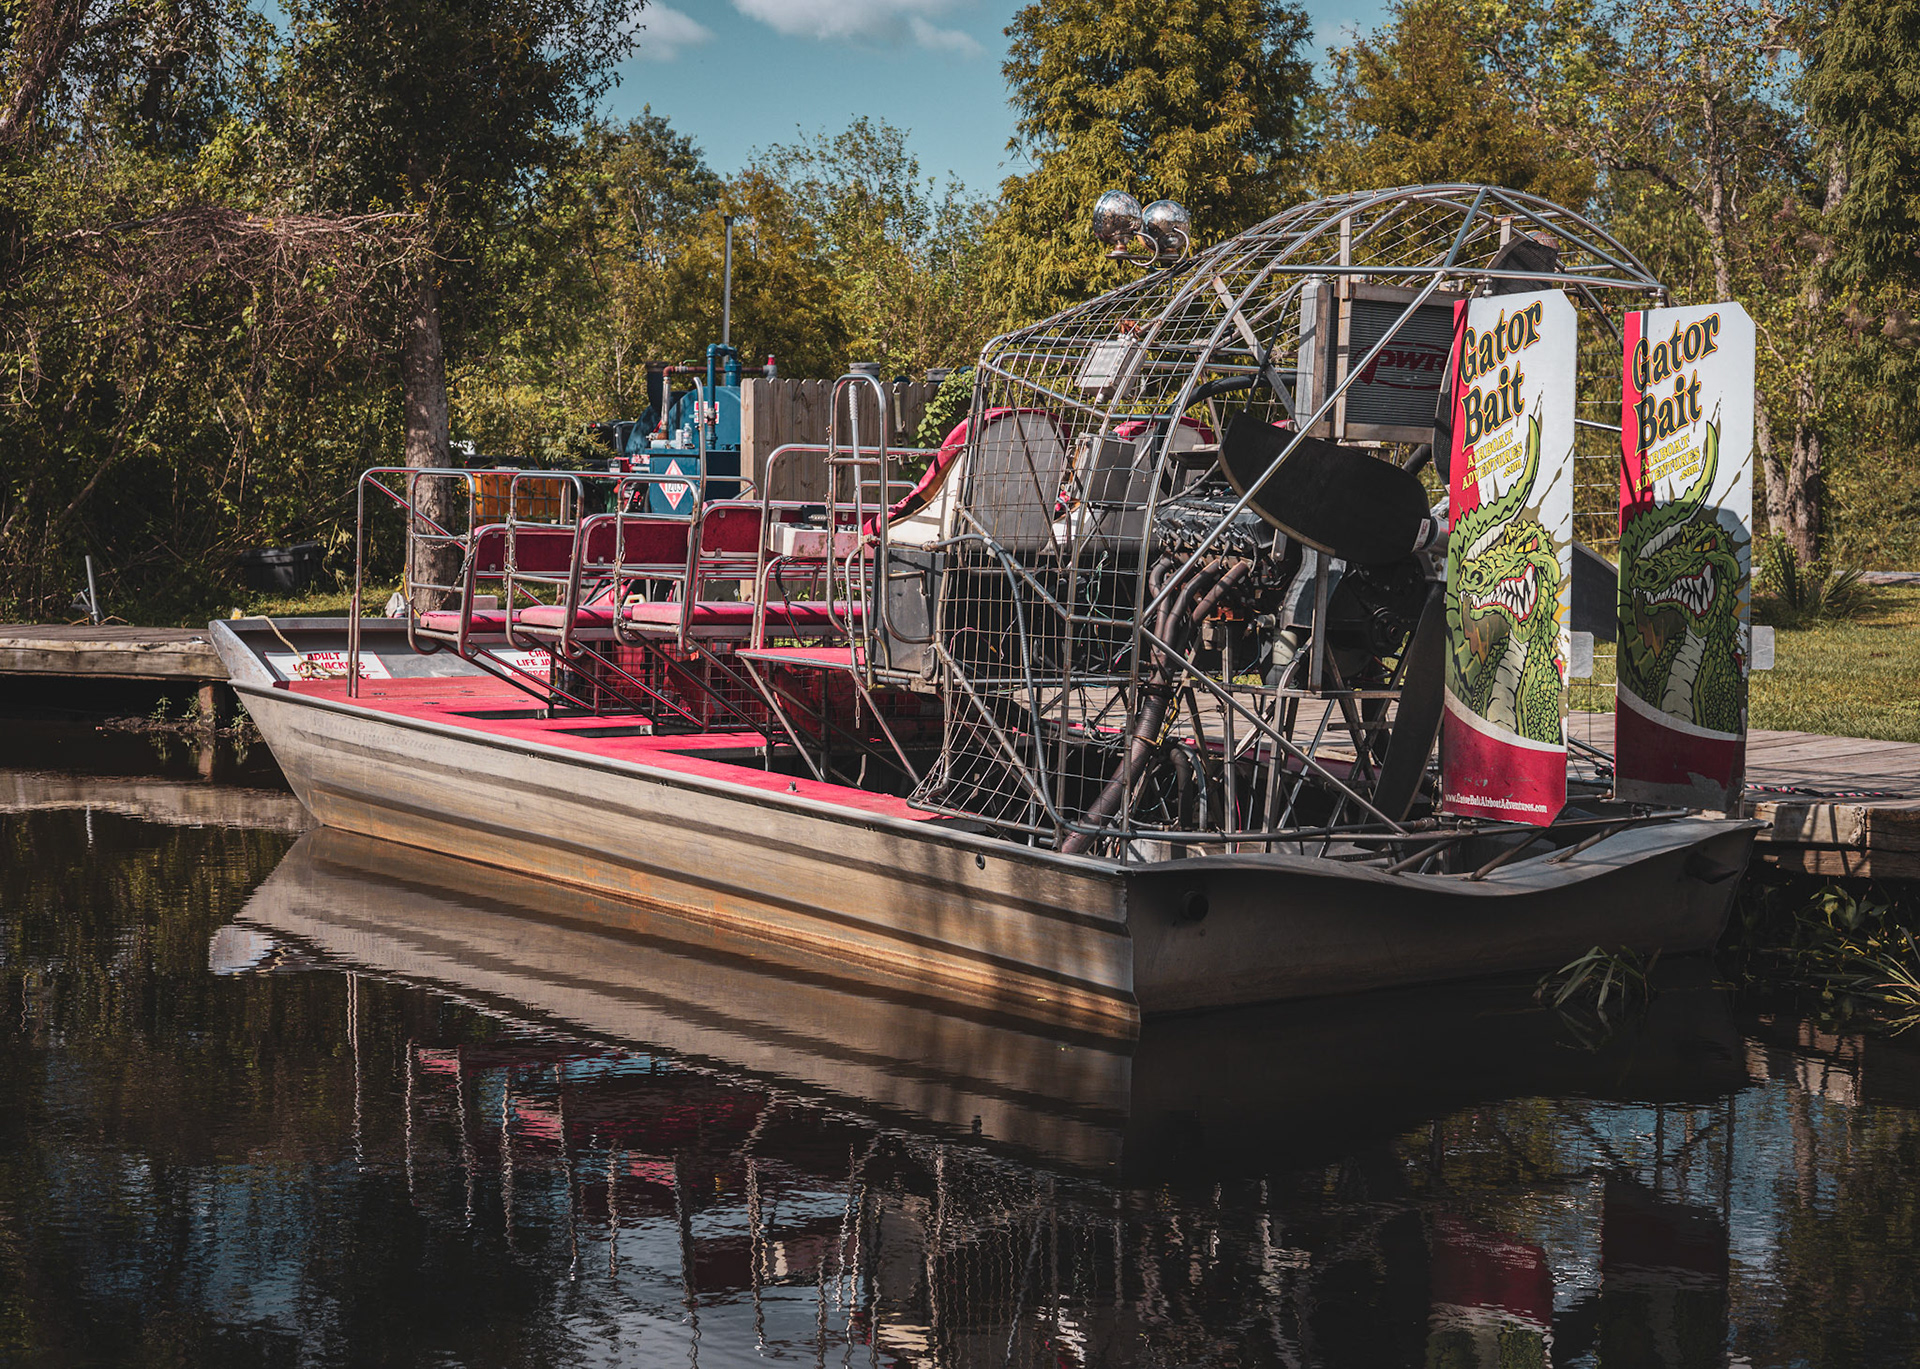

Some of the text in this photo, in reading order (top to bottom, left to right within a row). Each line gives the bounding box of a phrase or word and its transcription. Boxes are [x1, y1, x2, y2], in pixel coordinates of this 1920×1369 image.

[1460, 300, 1543, 386] Gator
[1631, 312, 1721, 394] Gator
[1461, 360, 1526, 453] Bait
[1633, 368, 1703, 457] Bait
[1461, 441, 1524, 491] ADVENTURES
[1467, 427, 1514, 470] AIRBOAT
[1503, 459, 1523, 478] .com
[1641, 432, 1690, 472] AIRBOAT
[667, 483, 683, 492] 1203
[1634, 446, 1700, 493] ADVENTURES
[1679, 463, 1701, 481] .com
[306, 652, 340, 662] ADULT
[321, 661, 366, 671] JACKS
[516, 658, 537, 667] LIFE
